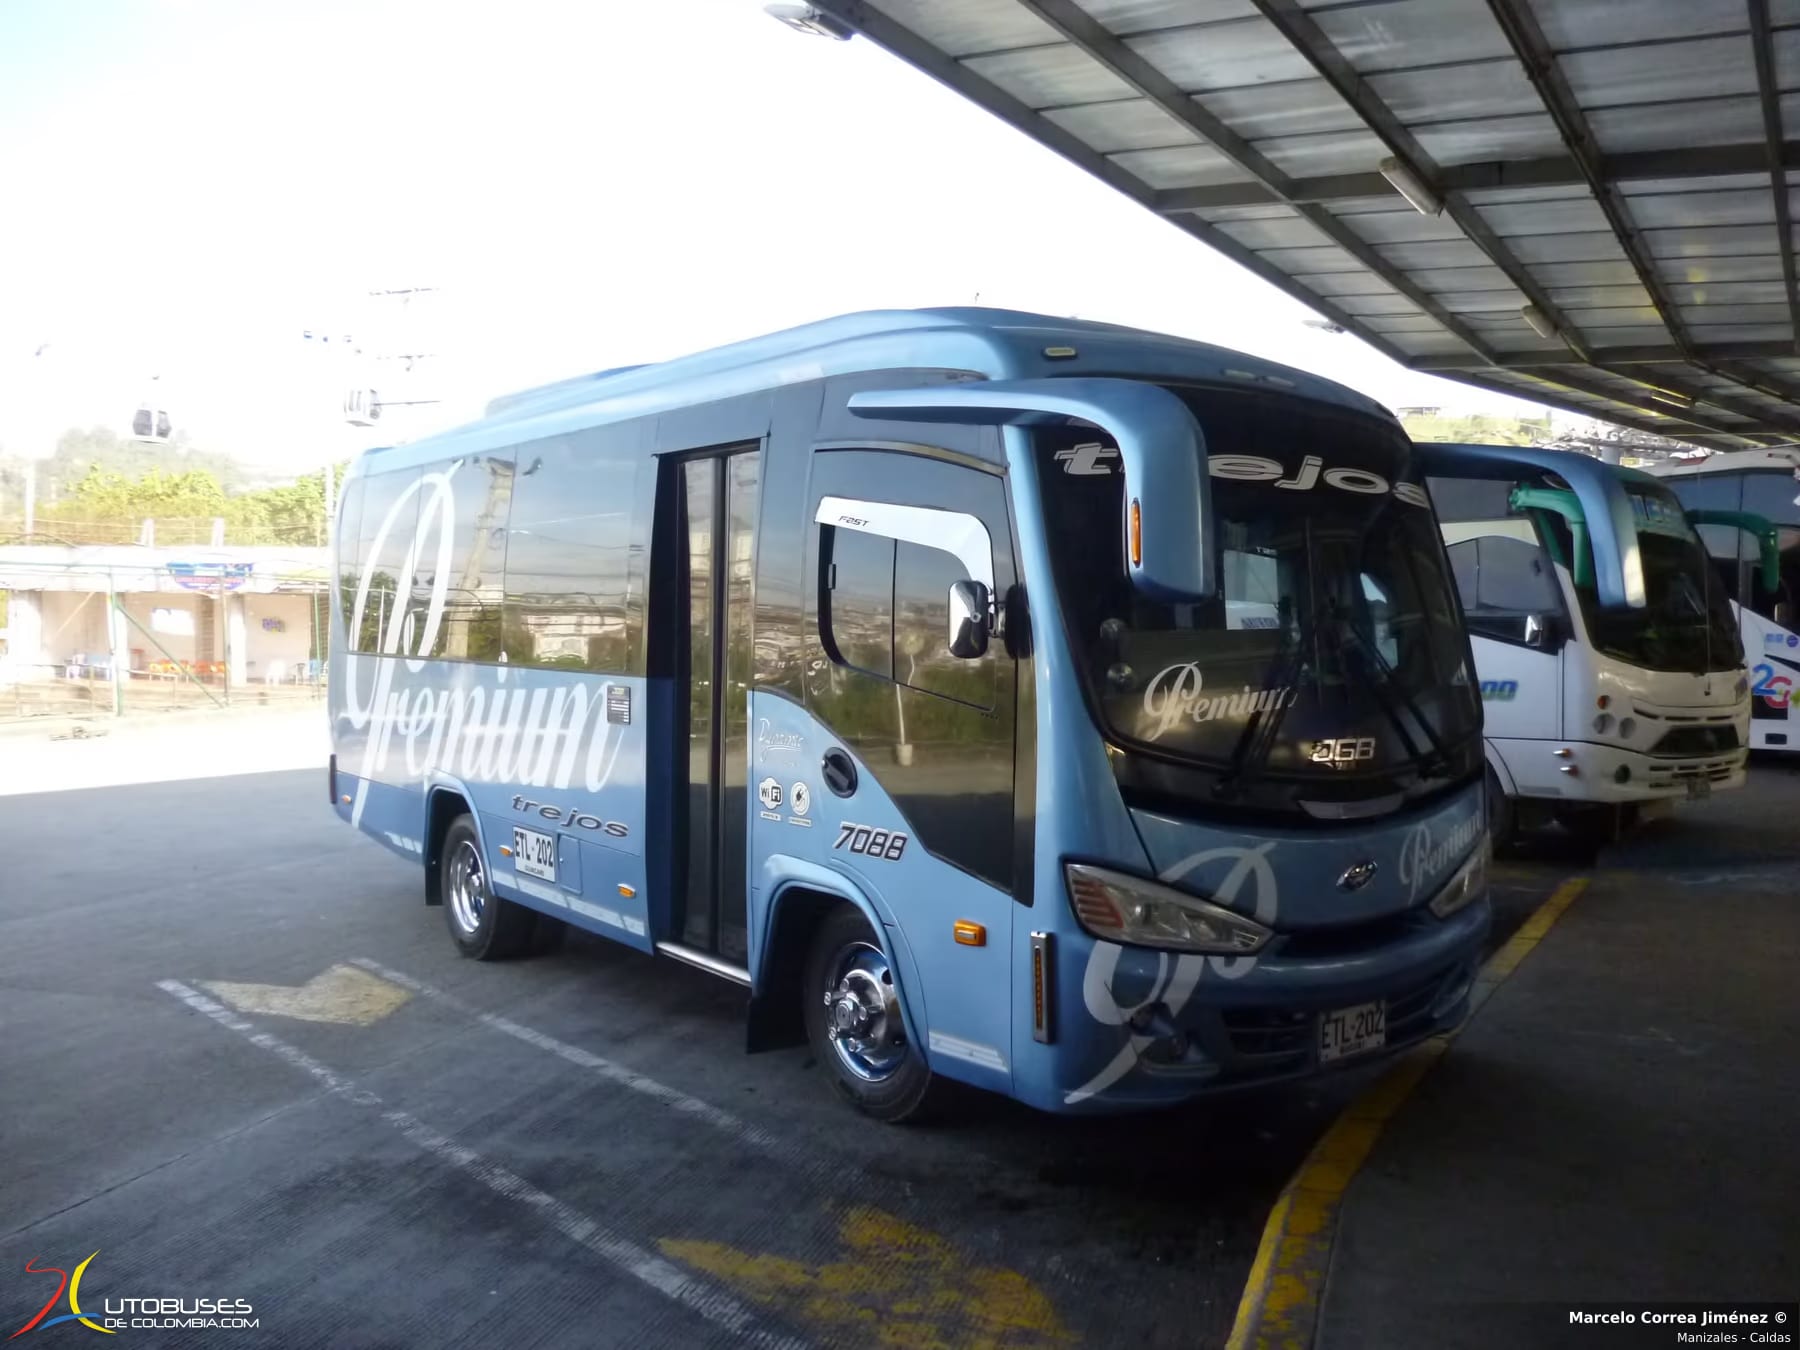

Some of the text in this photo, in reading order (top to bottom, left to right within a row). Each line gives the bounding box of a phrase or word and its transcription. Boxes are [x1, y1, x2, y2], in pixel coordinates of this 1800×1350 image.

[1053, 442, 1431, 511] tejos
[338, 459, 625, 828] Premium
[511, 793, 630, 838] trejos
[833, 822, 908, 861] 7088
